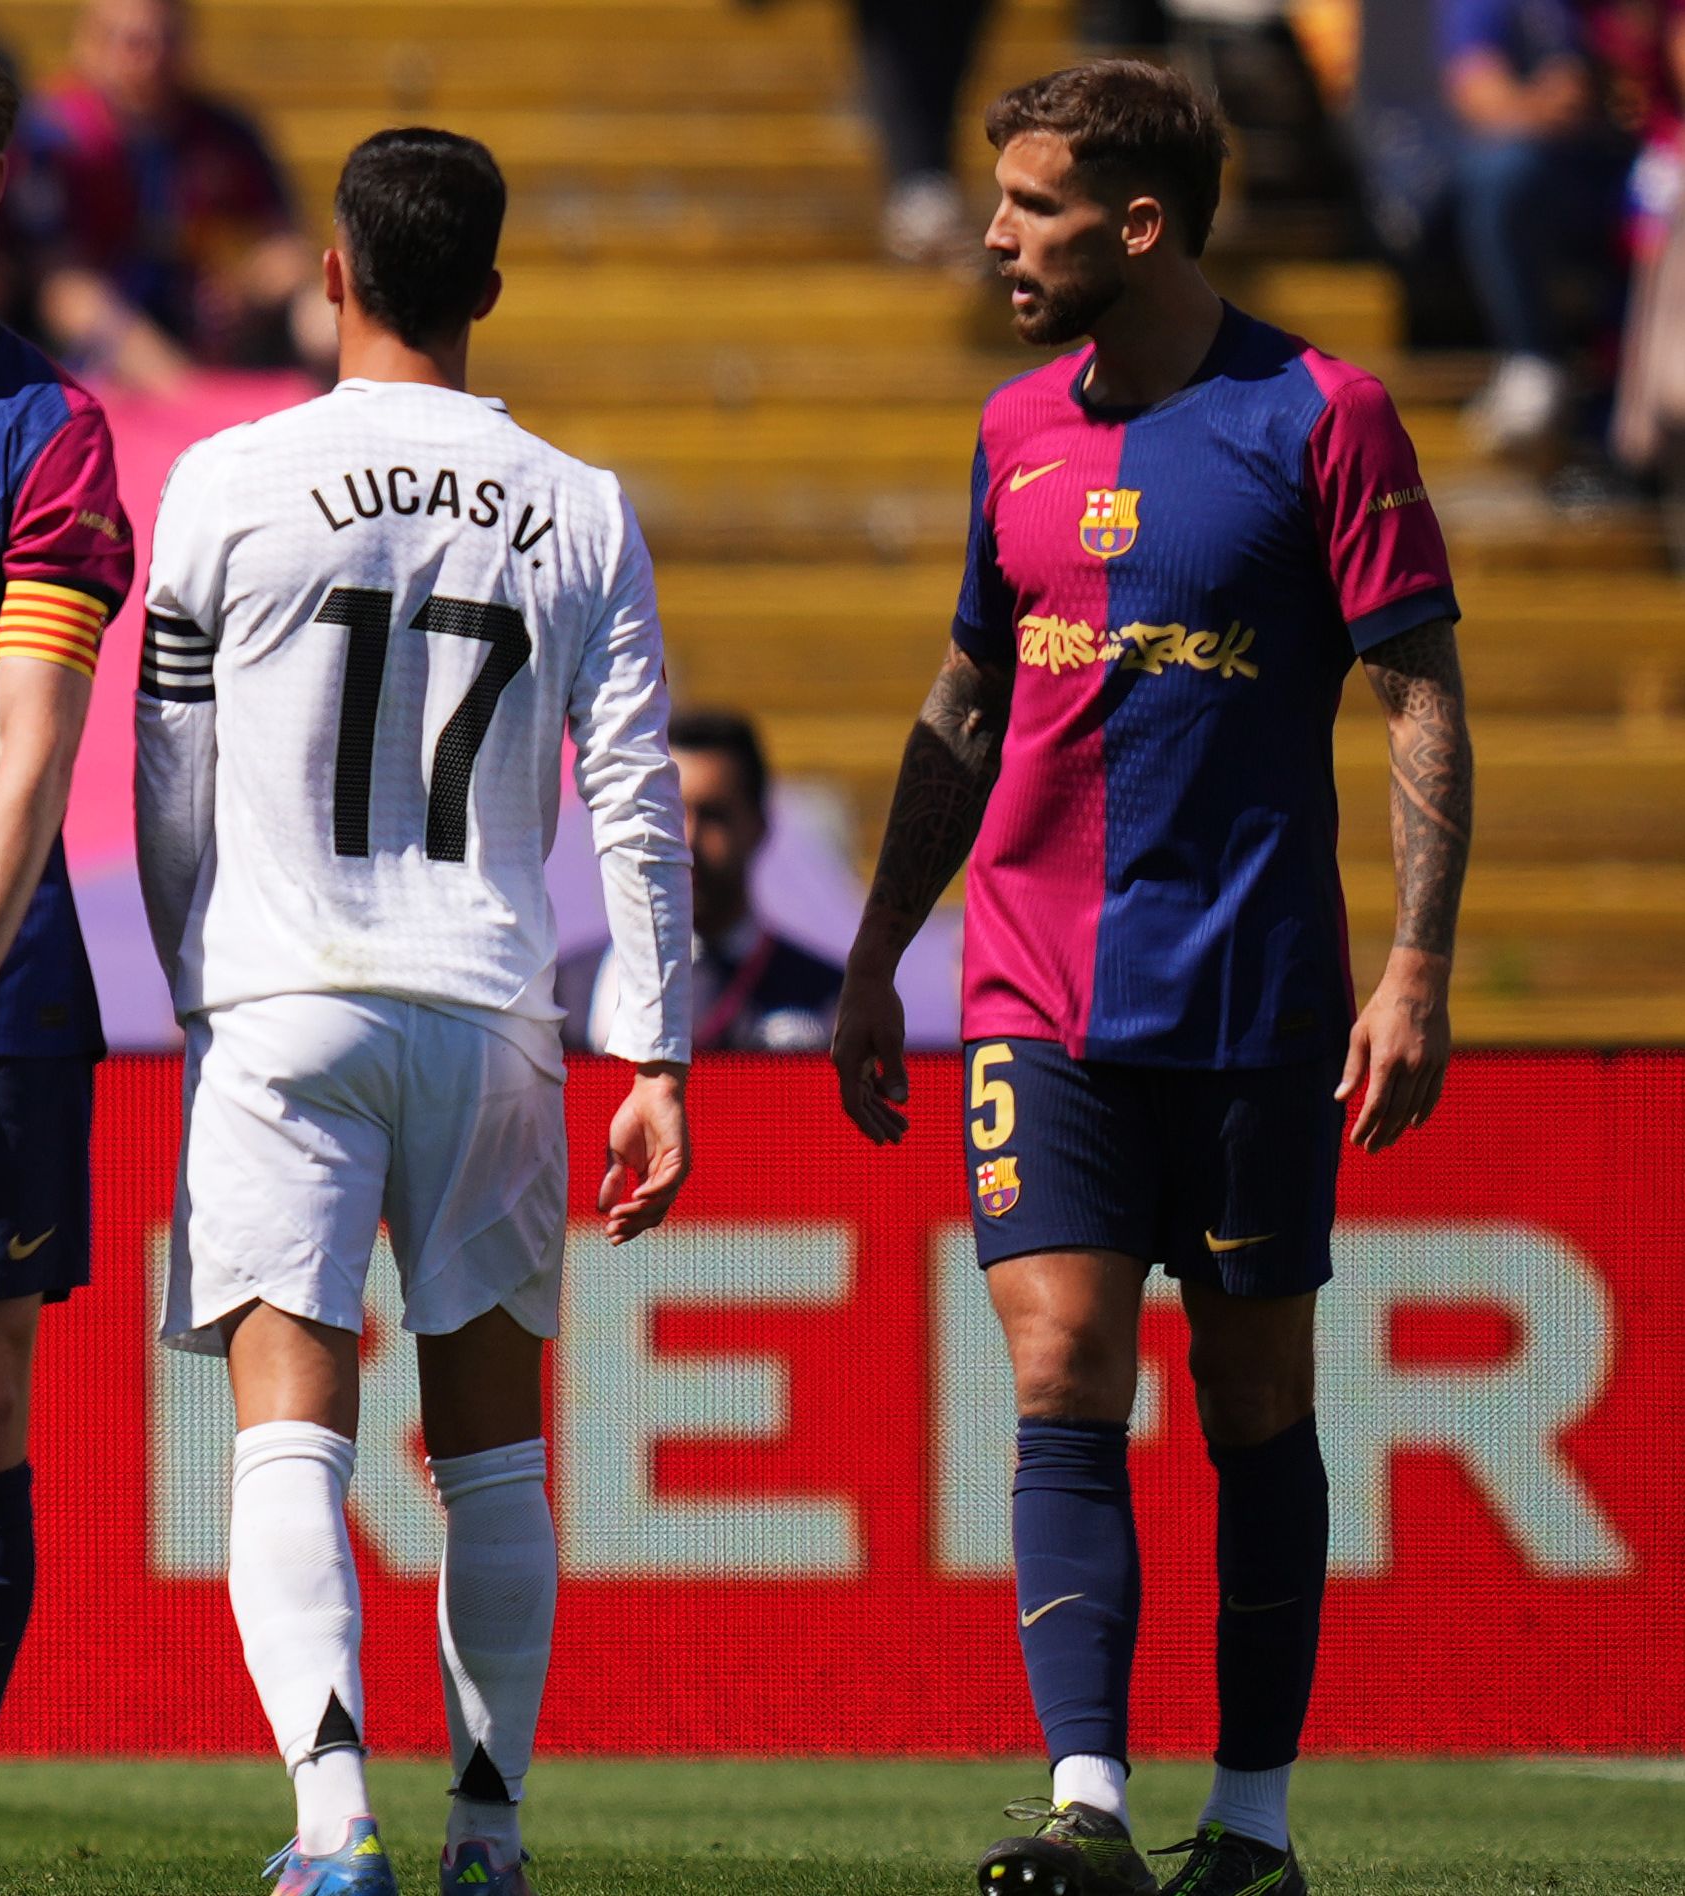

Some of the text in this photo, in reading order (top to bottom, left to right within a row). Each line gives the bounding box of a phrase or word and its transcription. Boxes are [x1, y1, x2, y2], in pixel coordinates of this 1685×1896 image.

[310, 466, 555, 570] LUCAS V.
[313, 586, 532, 863] 17
[970, 1042, 1015, 1151] 5
